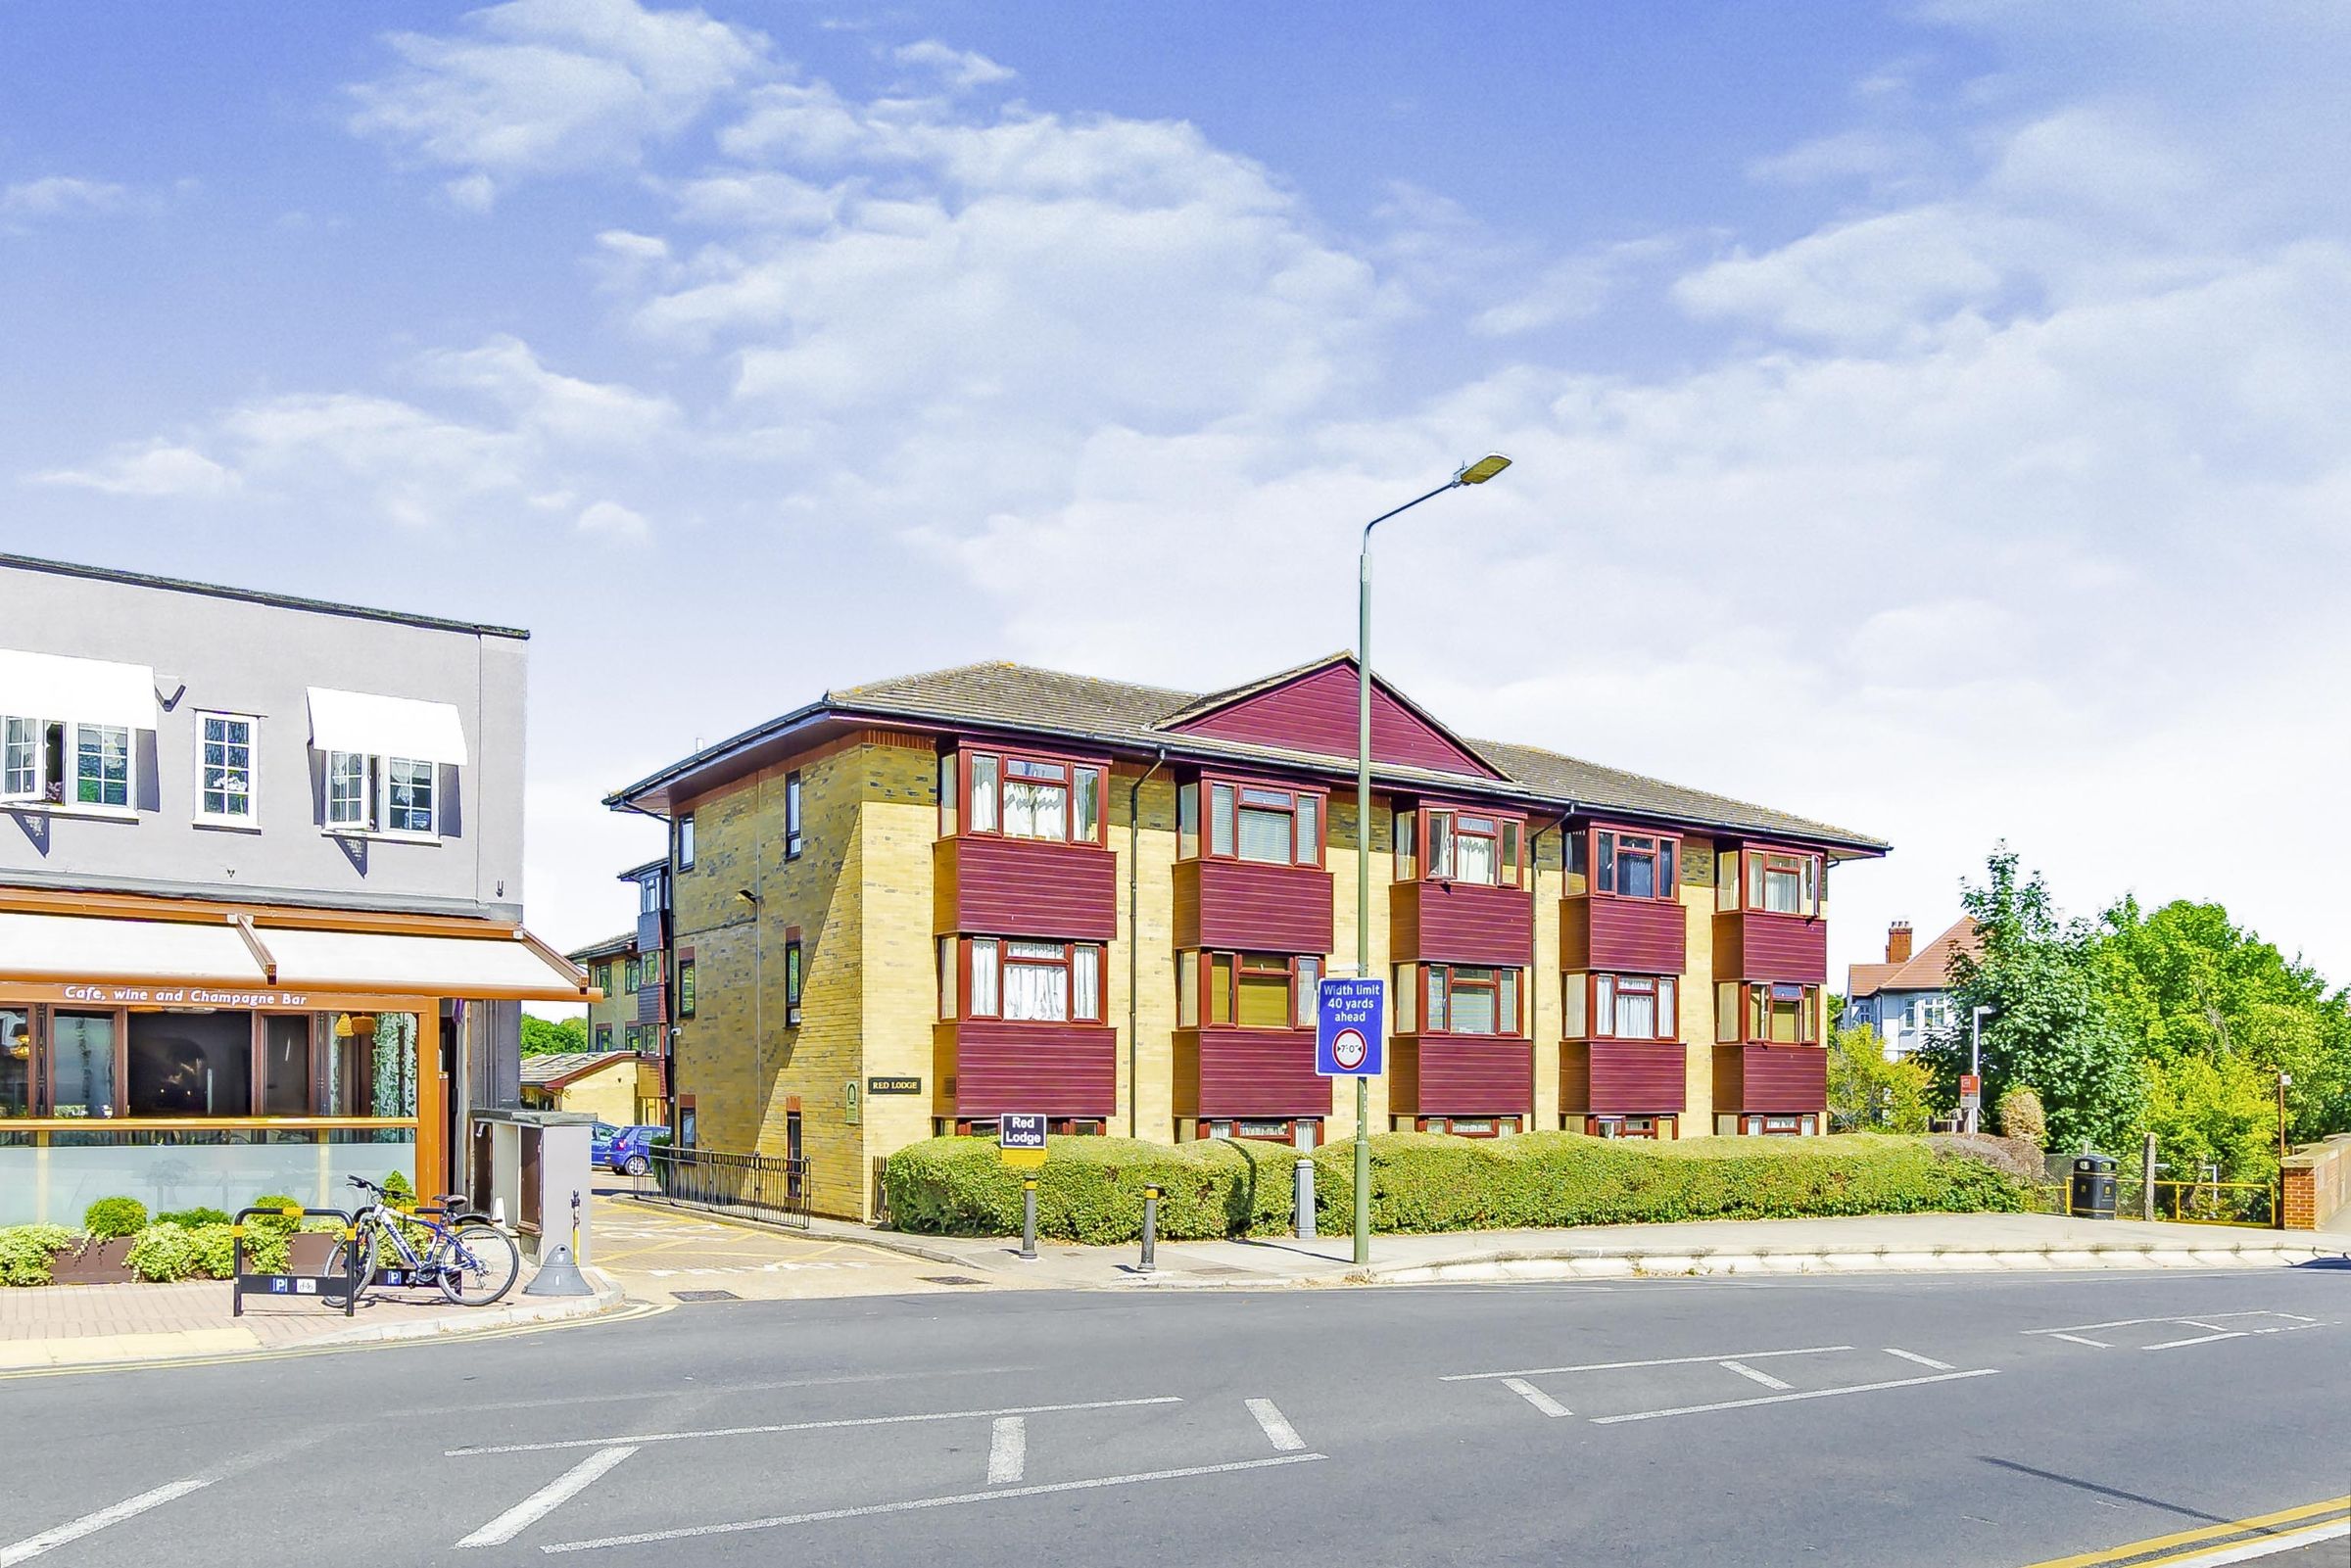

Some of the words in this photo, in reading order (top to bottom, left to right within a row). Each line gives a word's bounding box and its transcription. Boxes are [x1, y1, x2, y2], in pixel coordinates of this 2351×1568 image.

[1323, 984, 1353, 995] Width
[1356, 984, 1380, 995] limit
[114, 988, 148, 1000] wine
[155, 990, 183, 1002] and
[190, 990, 275, 1006] Champagne
[282, 993, 308, 1005] Bar
[1327, 998, 1342, 1009] 40
[1345, 998, 1374, 1011] yards
[1334, 1011, 1366, 1022] ahead
[1011, 1117, 1035, 1128] Red
[1005, 1130, 1041, 1145] Lodge
[390, 1271, 399, 1283] P
[275, 1278, 285, 1291] P
